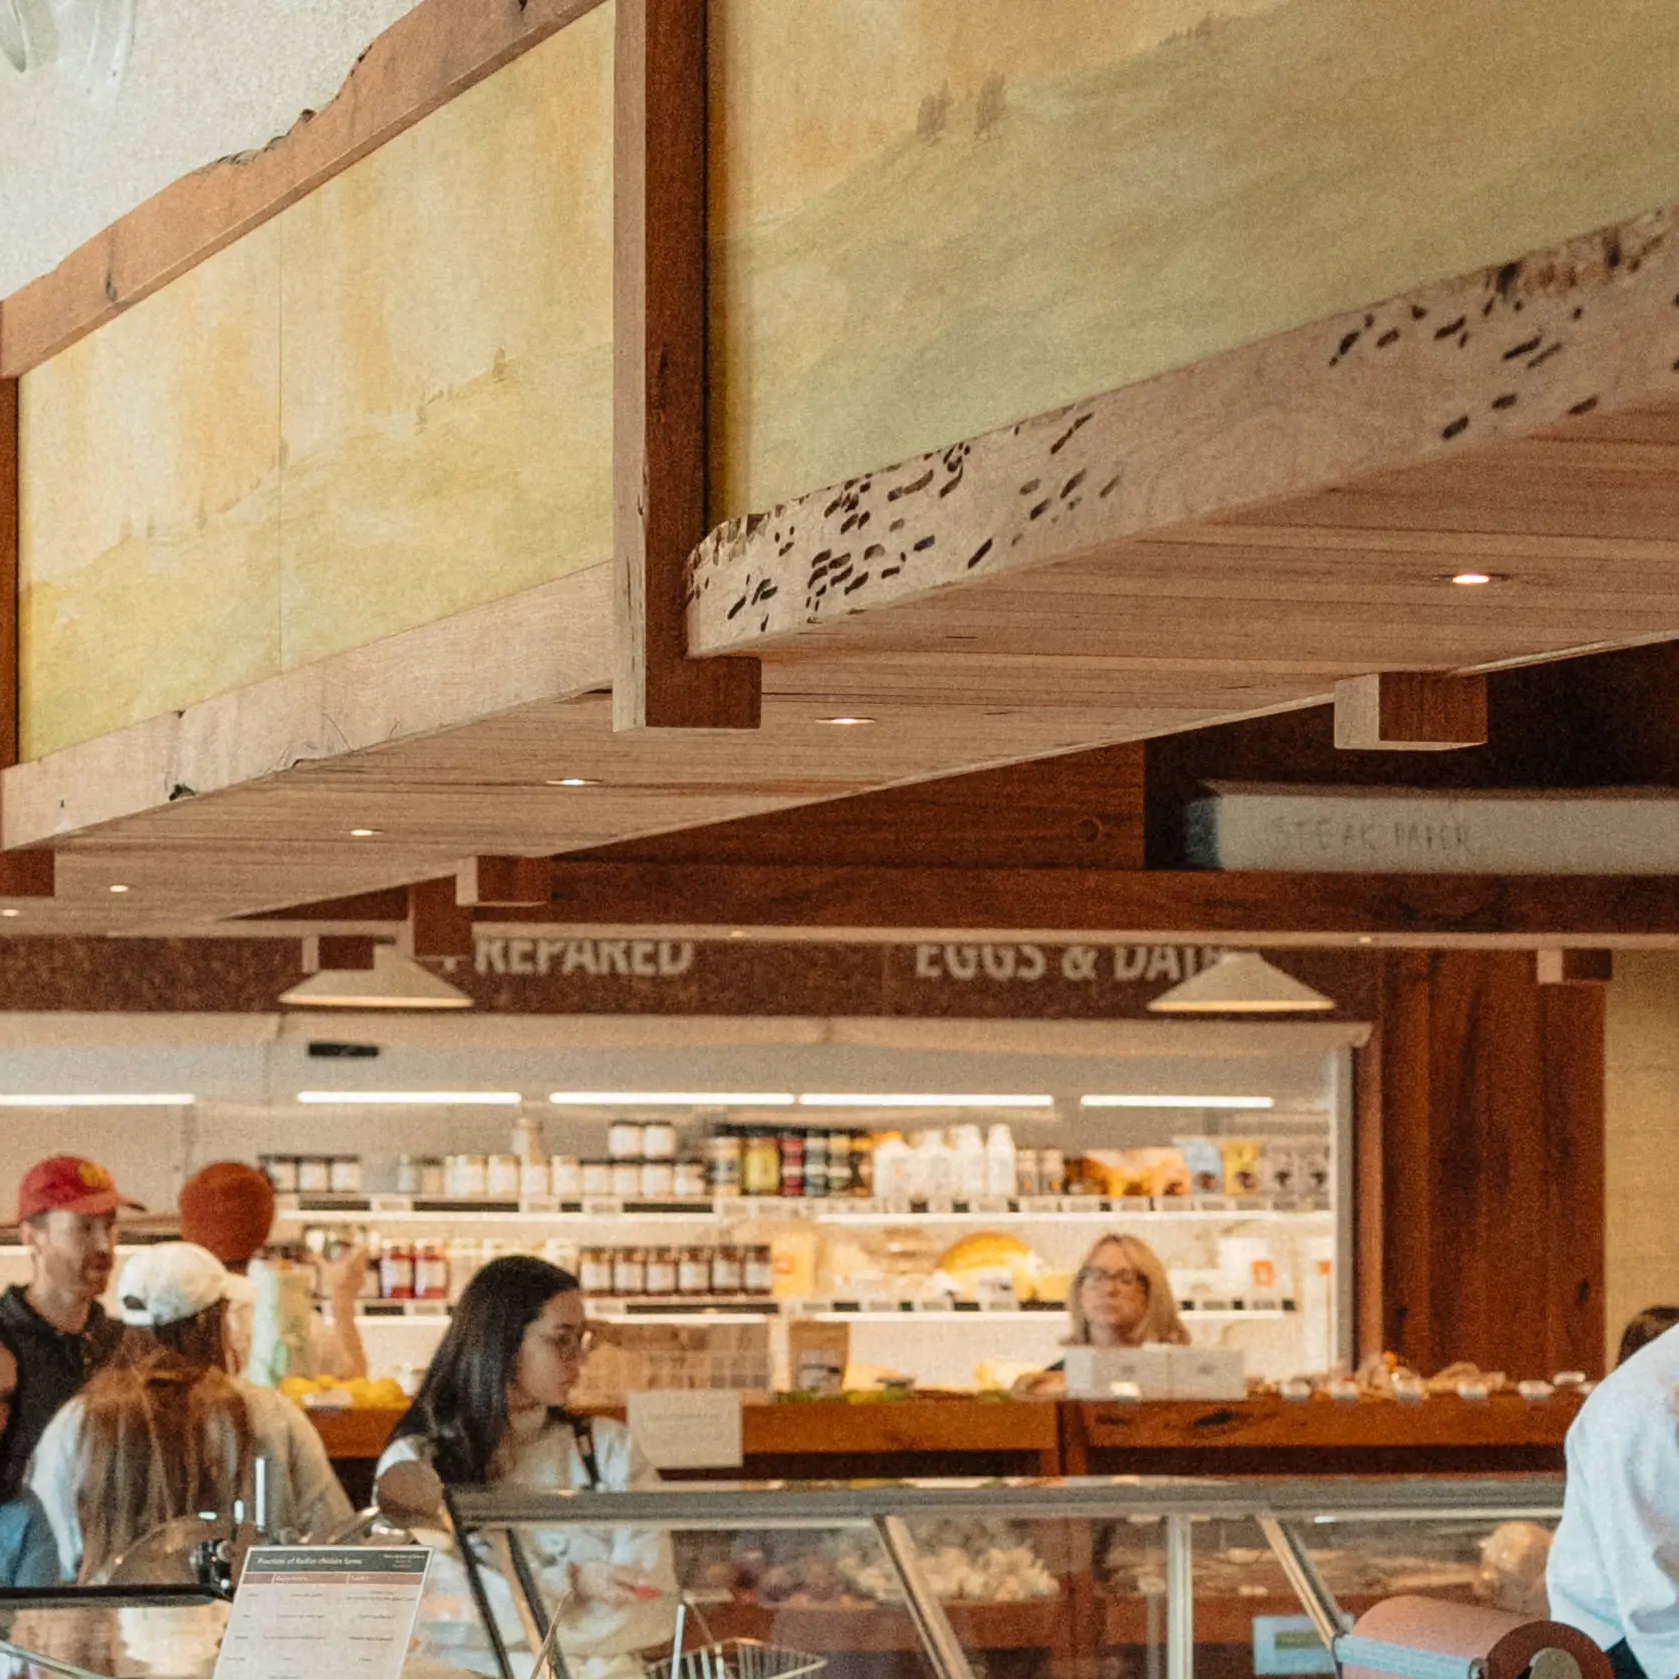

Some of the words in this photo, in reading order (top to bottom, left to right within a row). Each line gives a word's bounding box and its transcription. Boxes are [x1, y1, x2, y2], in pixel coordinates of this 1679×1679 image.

[443, 939, 694, 977] REPARED
[916, 944, 1047, 981] EGGS
[1061, 945, 1098, 982] &
[1114, 944, 1222, 981] DAI
